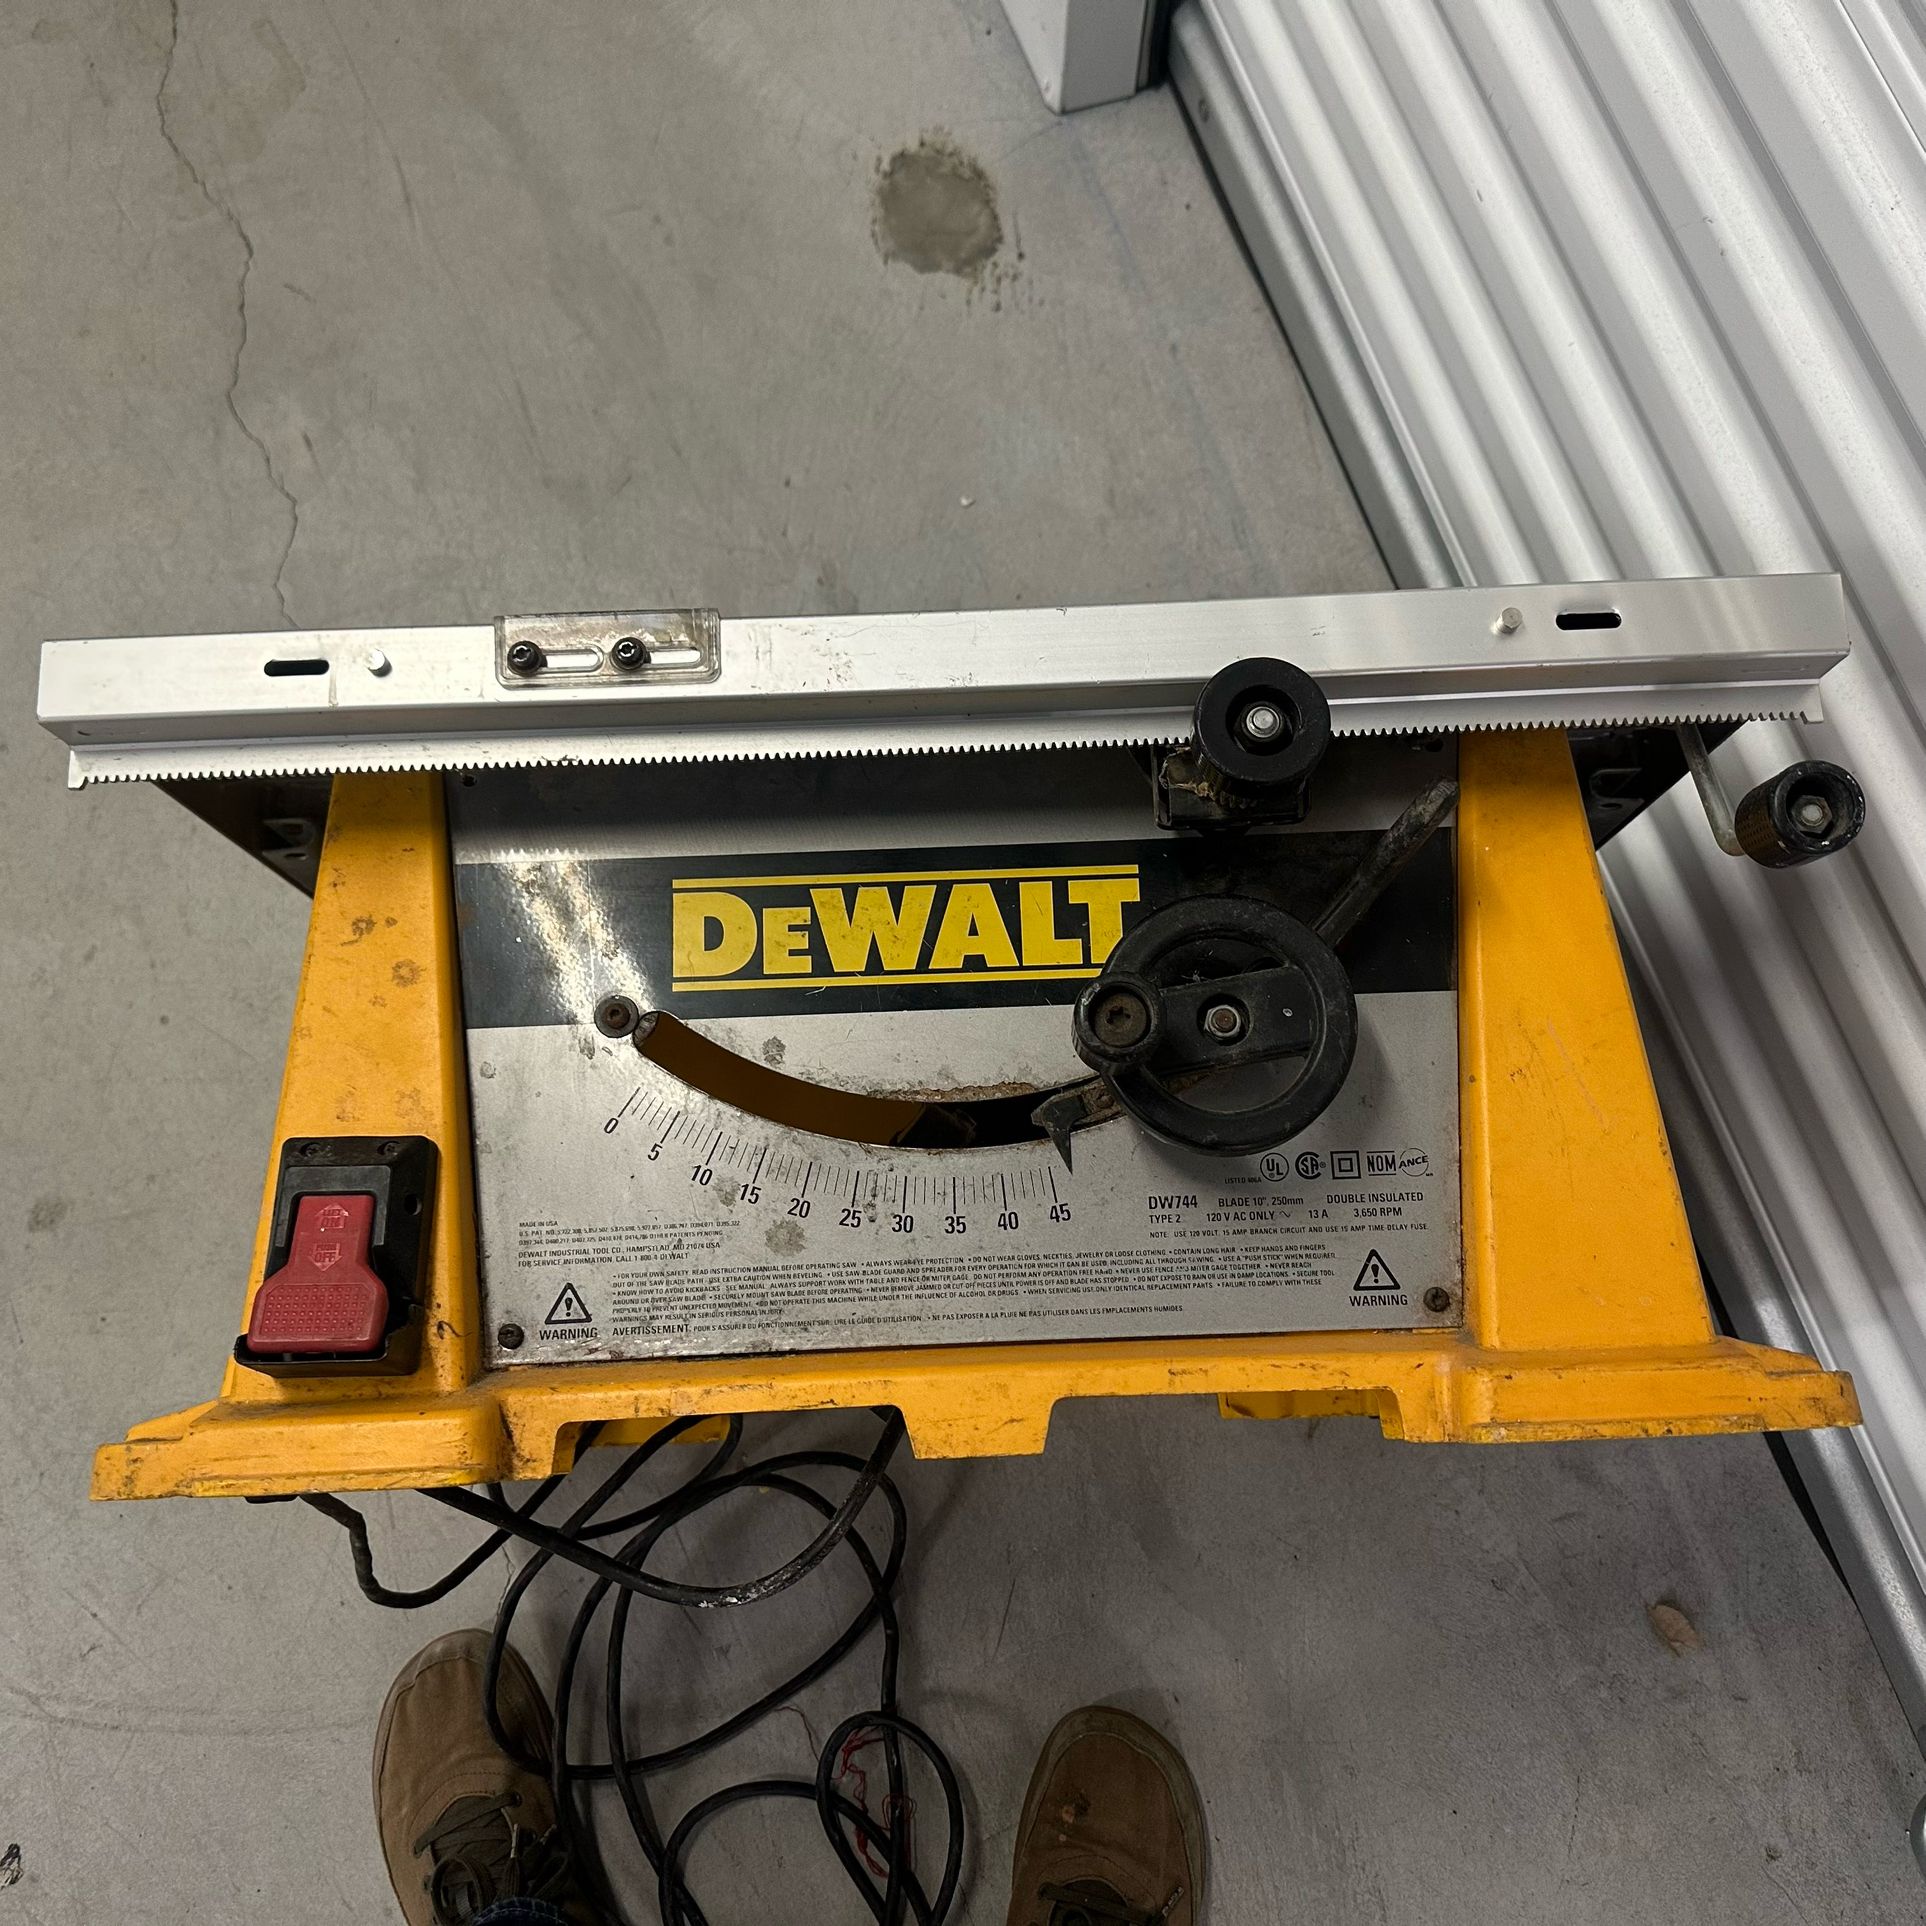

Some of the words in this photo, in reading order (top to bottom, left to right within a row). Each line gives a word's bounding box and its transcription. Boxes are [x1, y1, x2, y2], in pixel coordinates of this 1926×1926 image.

[672, 877, 1140, 978] DEWALT
[604, 1117, 619, 1134] 0
[648, 1143, 660, 1161] 5
[1367, 1154, 1396, 1172] NOM
[1398, 1155, 1428, 1169] ANCE
[690, 1164, 713, 1186] 10
[740, 1182, 762, 1204] 15
[1218, 1196, 1249, 1207] BLADE
[1271, 1195, 1303, 1205] 250mm
[1326, 1193, 1365, 1204] DOUBLE
[1368, 1191, 1423, 1202] INSULATED
[787, 1198, 811, 1219] 20
[1148, 1194, 1197, 1209] DW744
[838, 1208, 861, 1228] 25
[1050, 1203, 1071, 1222] 45
[1149, 1214, 1173, 1223] TYPE
[1175, 1213, 1180, 1222] 2
[1206, 1212, 1220, 1222] 120
[1223, 1212, 1229, 1221] V
[1233, 1211, 1246, 1221] AC
[1249, 1210, 1274, 1220] ONLY
[1308, 1209, 1318, 1218] 13
[1321, 1208, 1328, 1218] A
[1353, 1207, 1377, 1218] 3,650
[1380, 1206, 1402, 1216] RPM
[892, 1214, 914, 1233] 30
[944, 1216, 966, 1234] 35
[998, 1212, 1018, 1230] 40
[549, 1248, 589, 1256] INDUSTRIAL
[1349, 1294, 1408, 1307] WARNING
[1102, 1306, 1152, 1314] EMPLACEMENTS
[540, 1326, 598, 1341] WARNING
